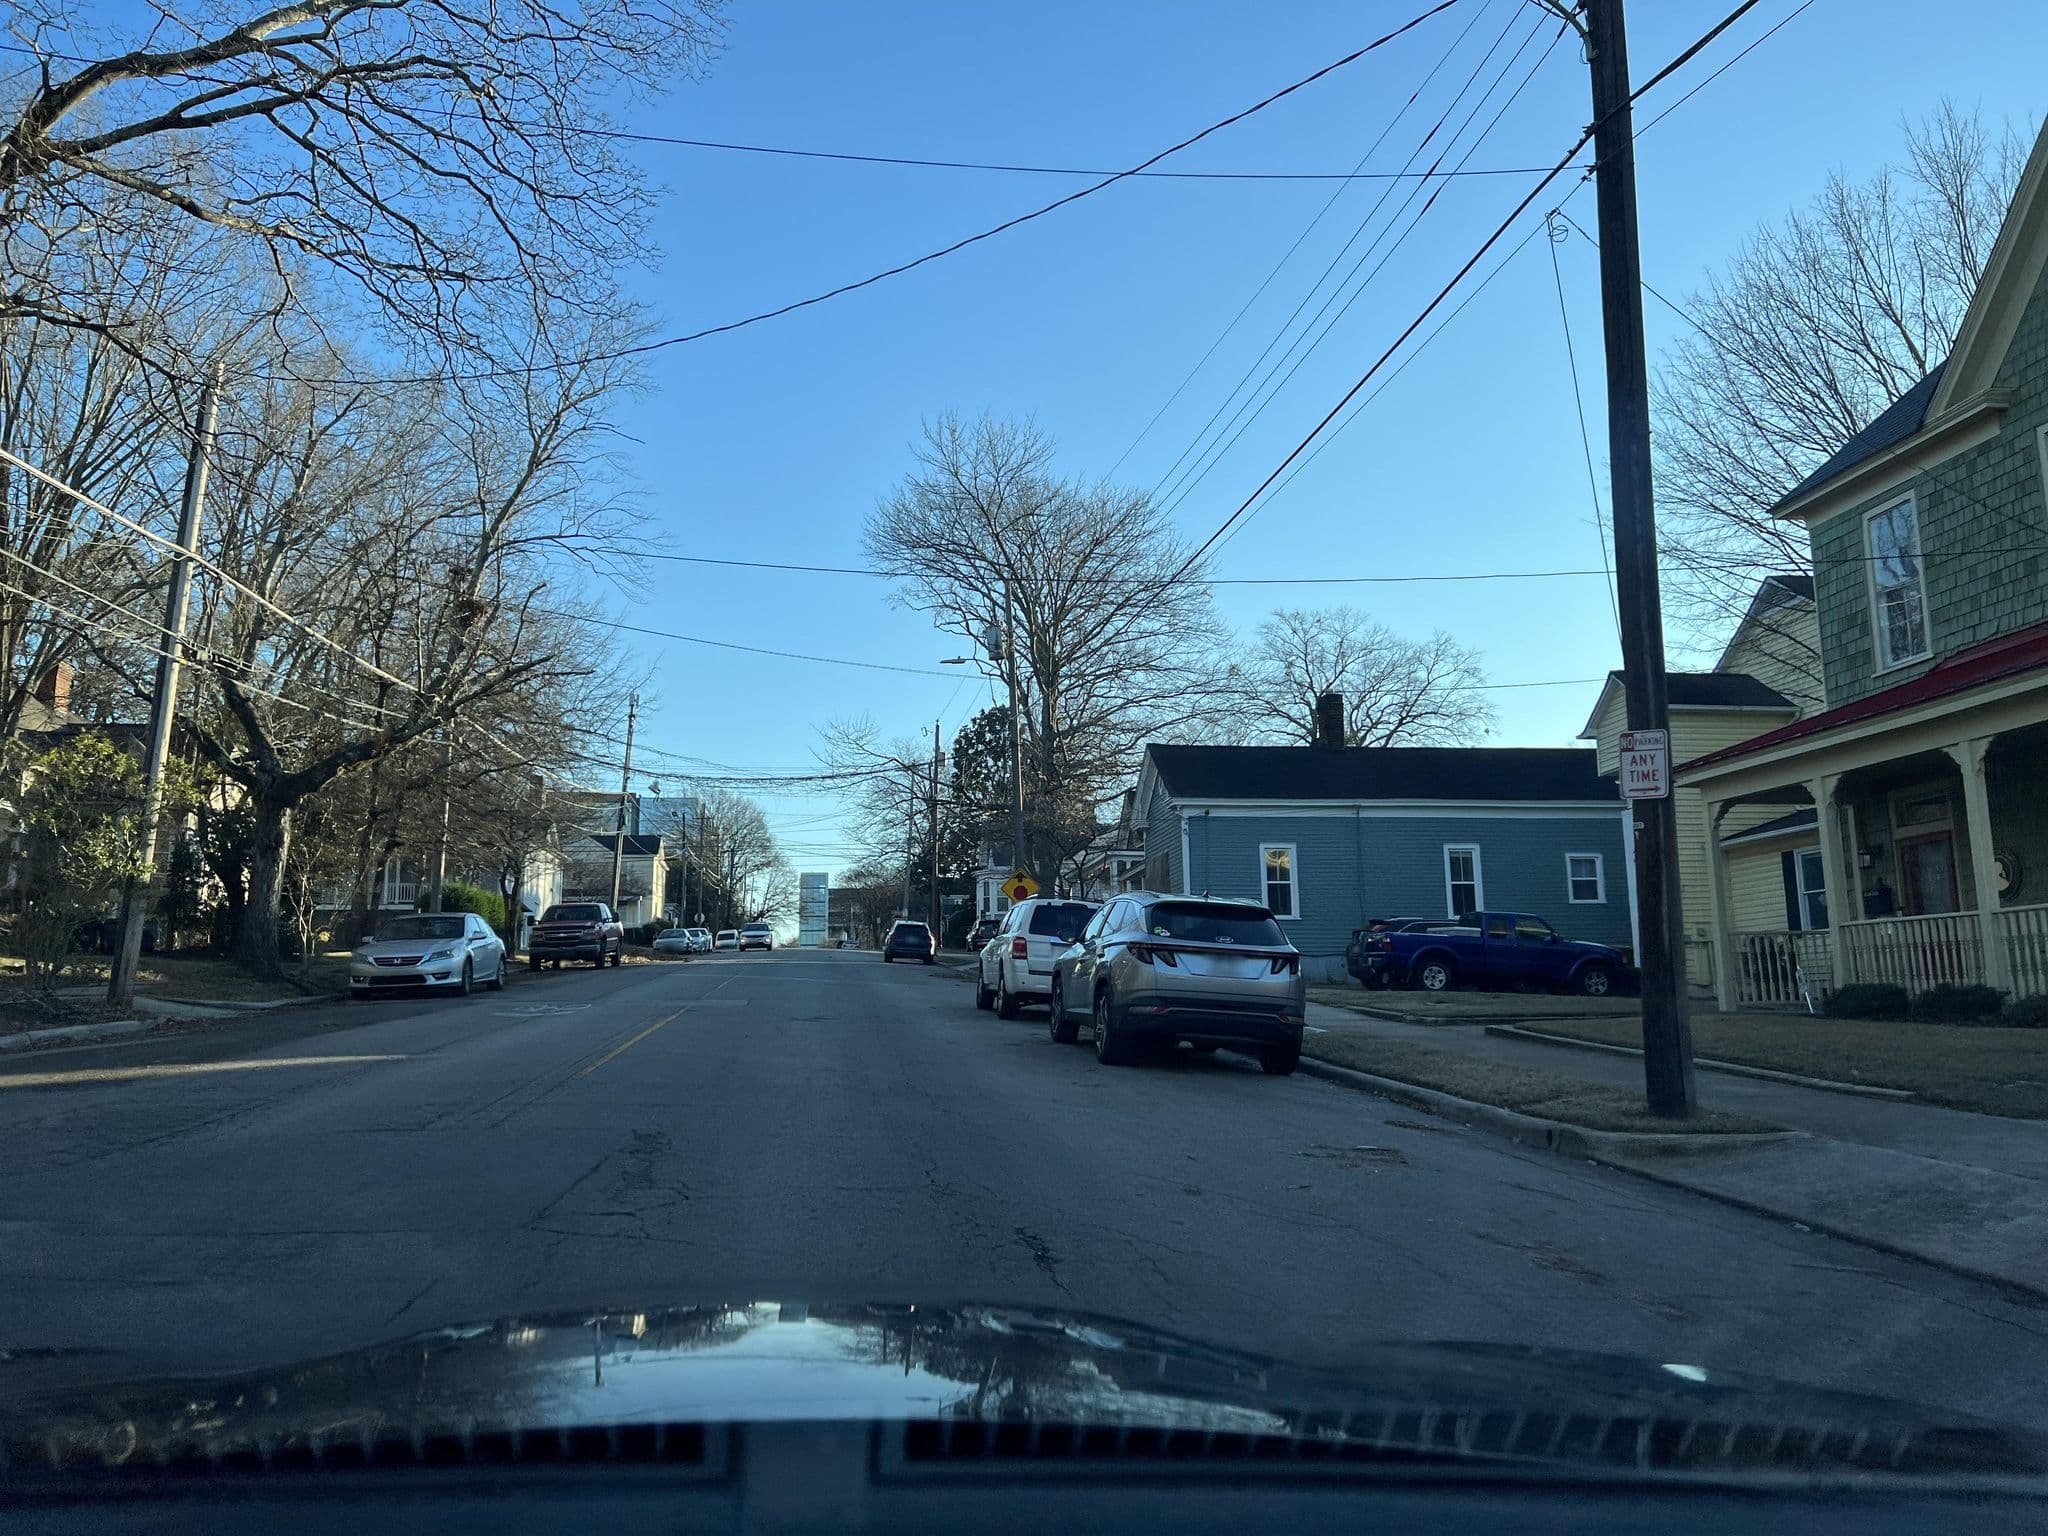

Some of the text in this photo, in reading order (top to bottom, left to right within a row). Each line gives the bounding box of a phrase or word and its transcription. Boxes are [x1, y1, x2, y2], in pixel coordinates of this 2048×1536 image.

[1620, 736, 1633, 749] NO
[1630, 753, 1656, 767] ANY
[1630, 769, 1659, 783] TIME
